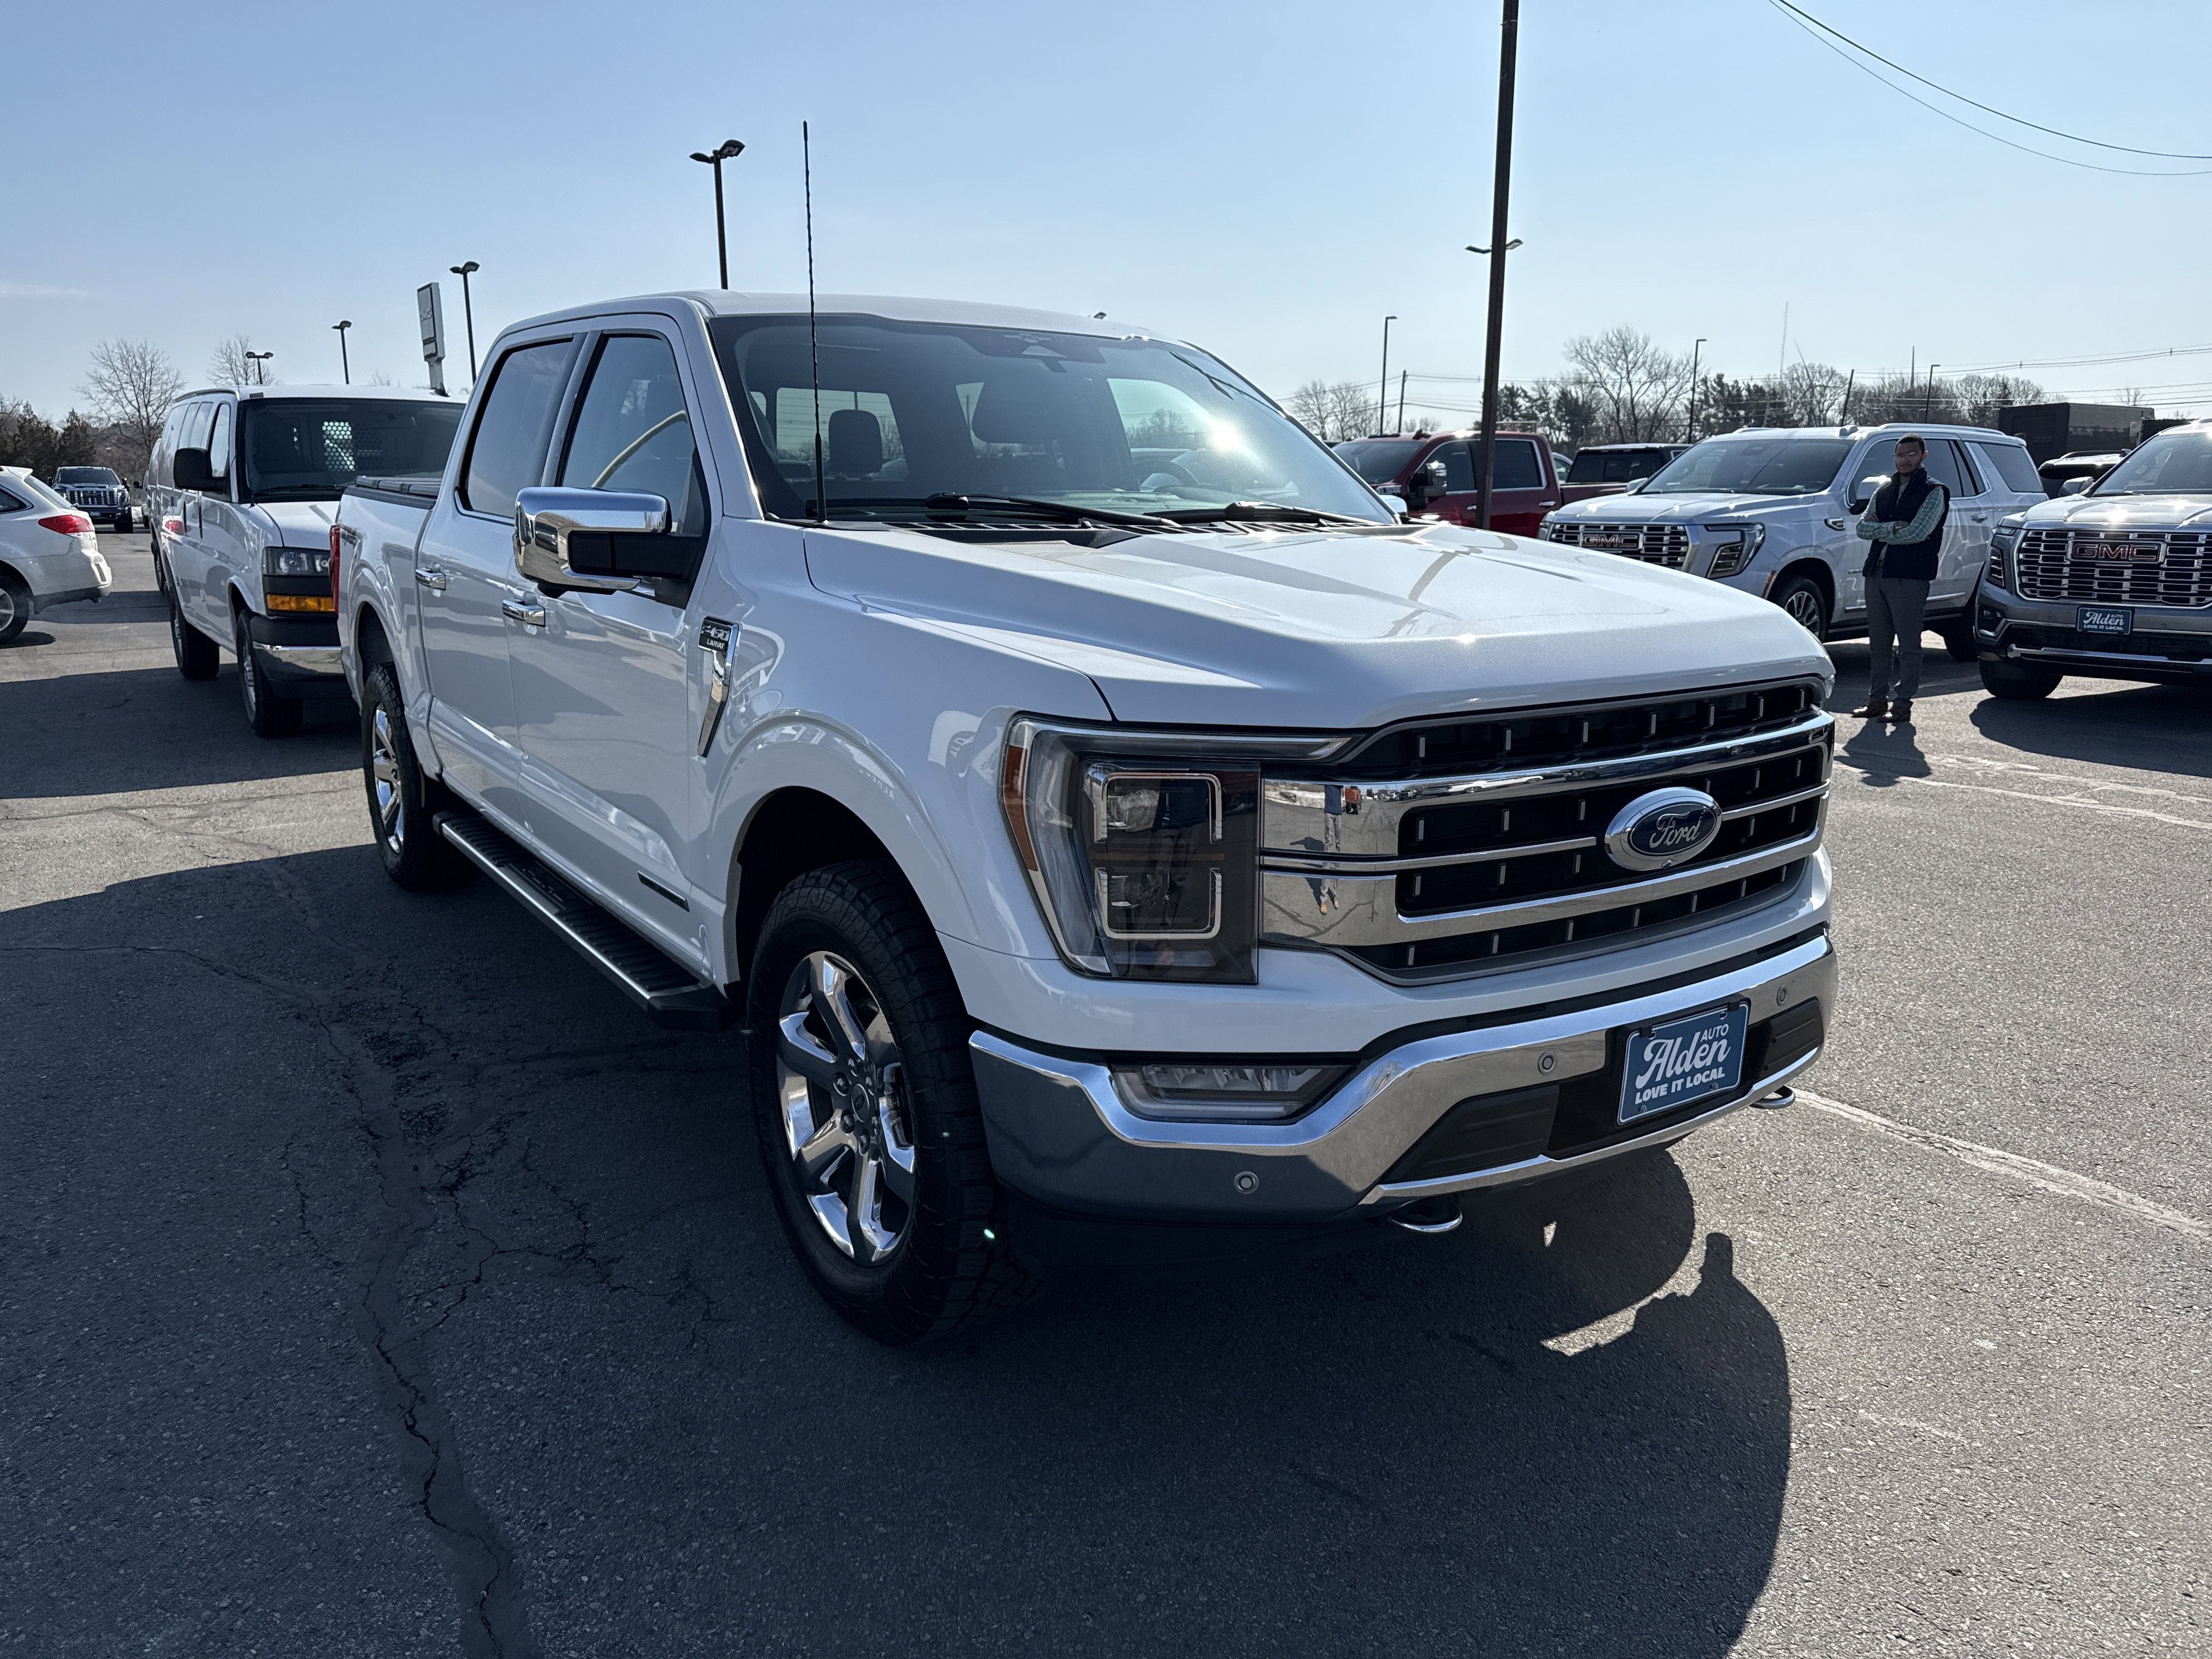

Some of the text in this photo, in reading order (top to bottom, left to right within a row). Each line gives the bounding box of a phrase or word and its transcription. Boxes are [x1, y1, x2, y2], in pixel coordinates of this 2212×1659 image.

[1583, 534, 1638, 548] GMC
[2072, 543, 2158, 560] GMC
[2083, 611, 2125, 626] Alden
[707, 639, 725, 649] LARIAT
[1649, 811, 1702, 849] Ford
[1700, 1023, 1729, 1042] AUTO
[1635, 1031, 1731, 1089] Alden
[1635, 1066, 1725, 1105] LOVE IT LOCAL
